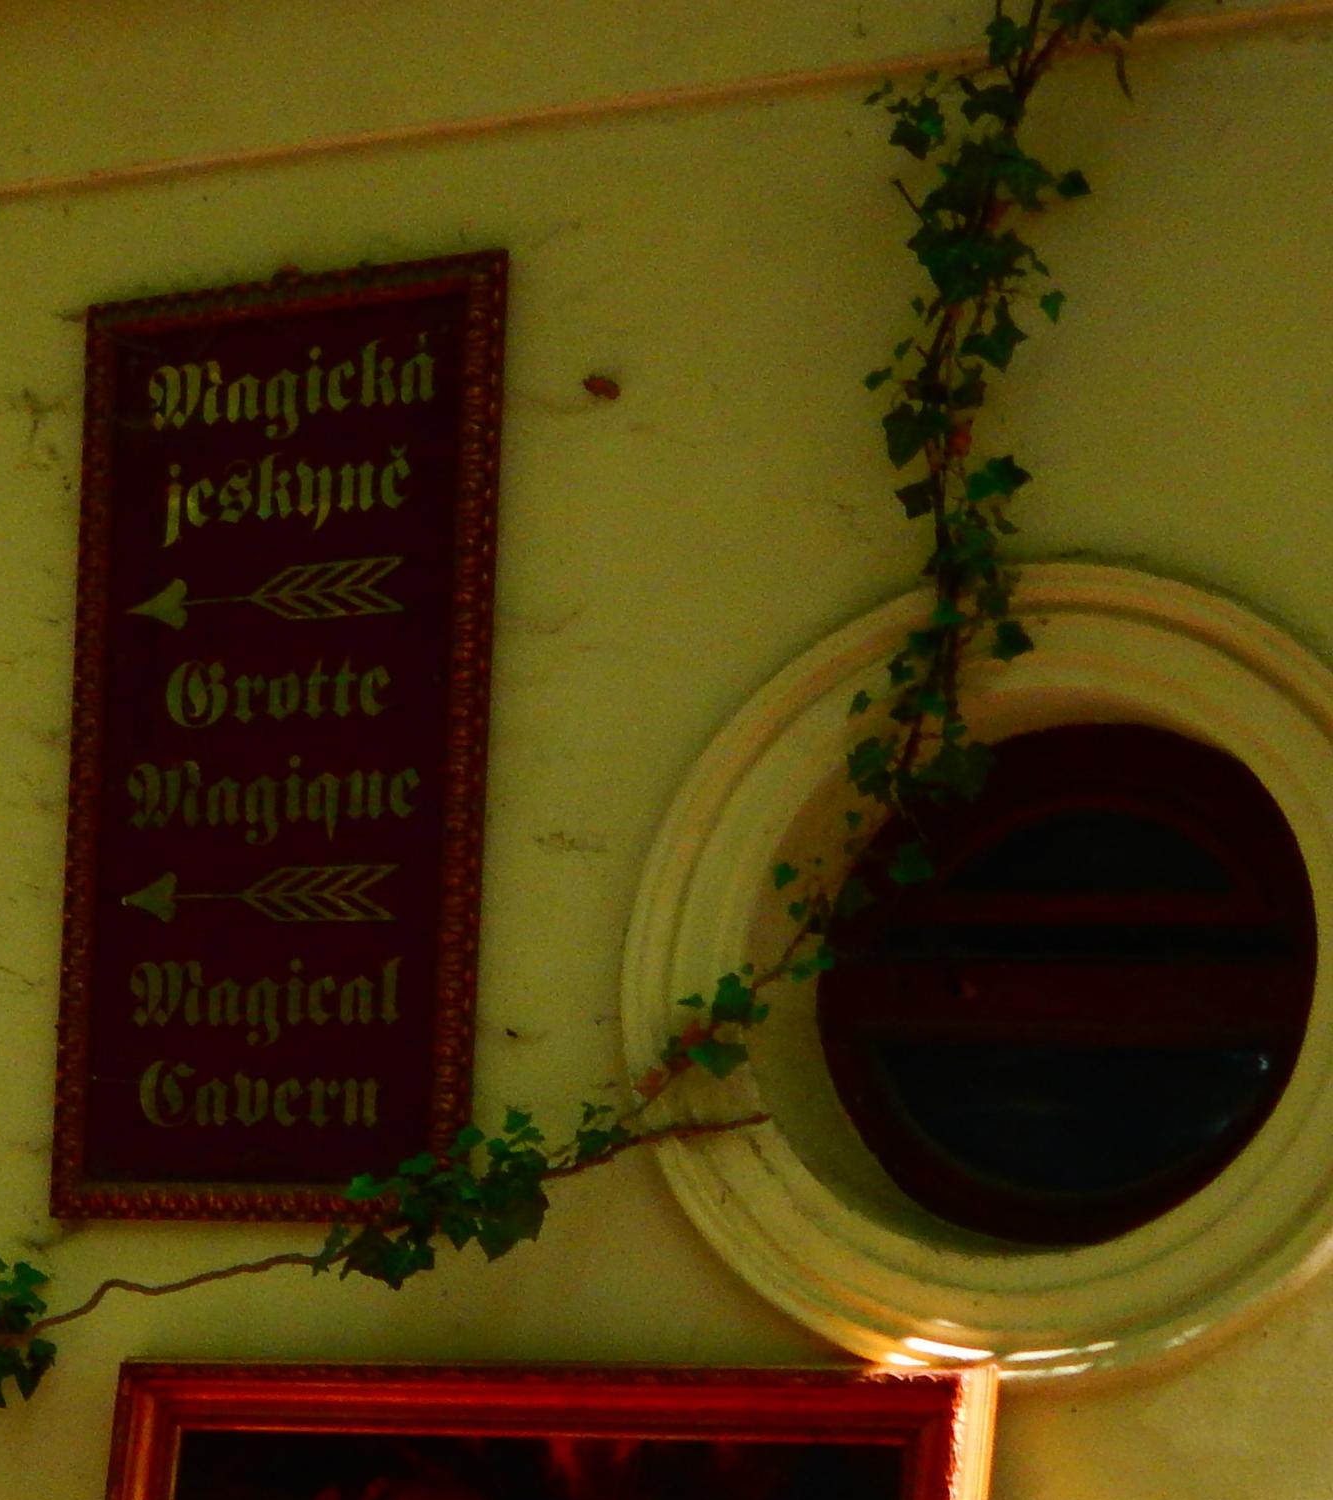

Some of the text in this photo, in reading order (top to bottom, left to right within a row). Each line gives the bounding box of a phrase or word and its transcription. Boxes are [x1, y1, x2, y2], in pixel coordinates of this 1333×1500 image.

[149, 332, 435, 440] Magická
[162, 444, 412, 548] jeskyně
[165, 657, 391, 729] Grotte
[126, 754, 422, 845] Magique
[130, 955, 405, 1046] Magical
[138, 1059, 383, 1128] Cavern
